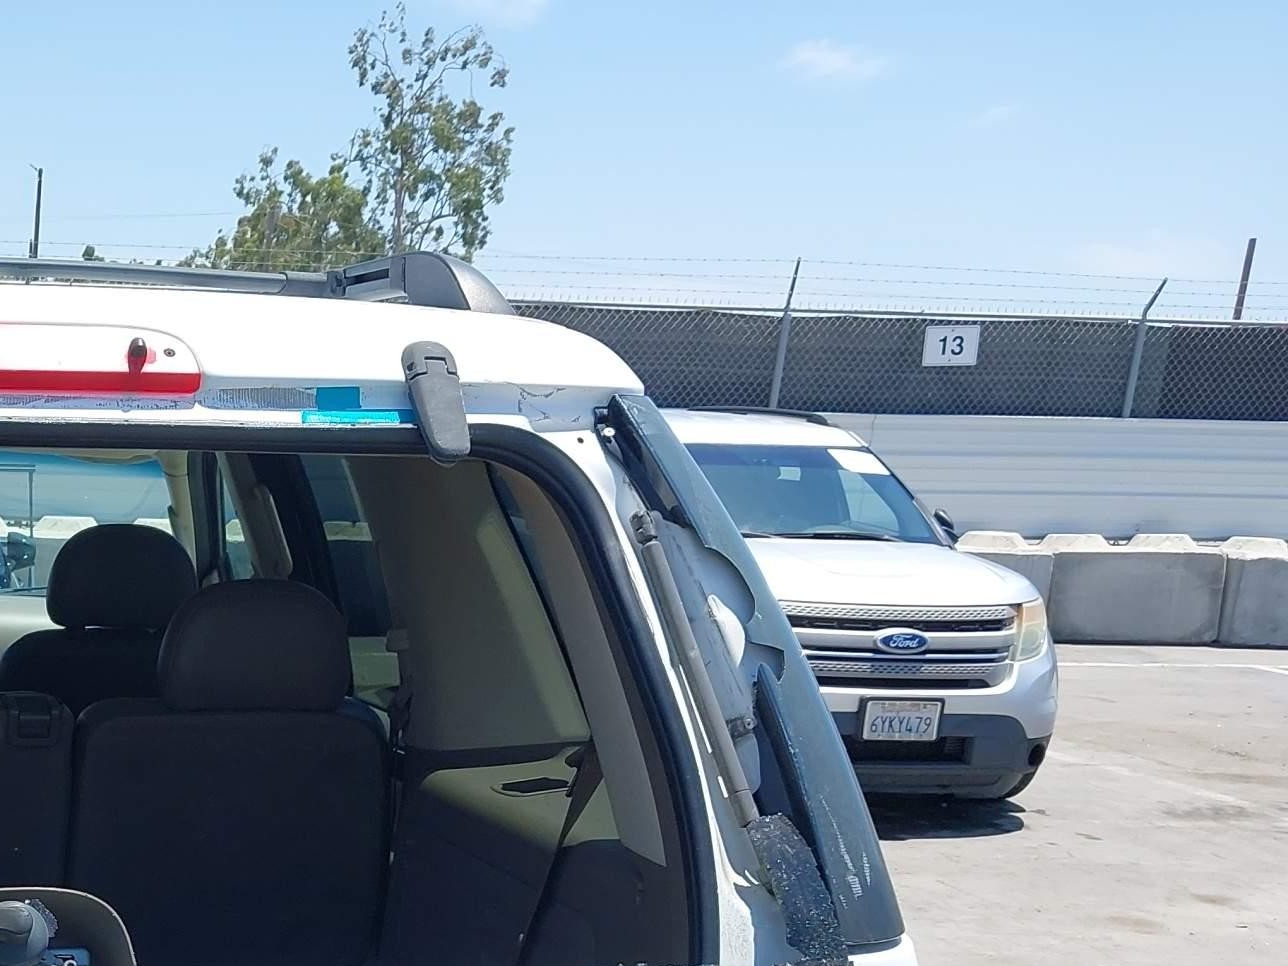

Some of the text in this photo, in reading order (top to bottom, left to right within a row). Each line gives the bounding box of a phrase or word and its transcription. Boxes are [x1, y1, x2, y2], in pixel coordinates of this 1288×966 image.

[938, 335, 964, 356] 13
[889, 634, 920, 648] Ford
[871, 716, 931, 733] 6YKY479
